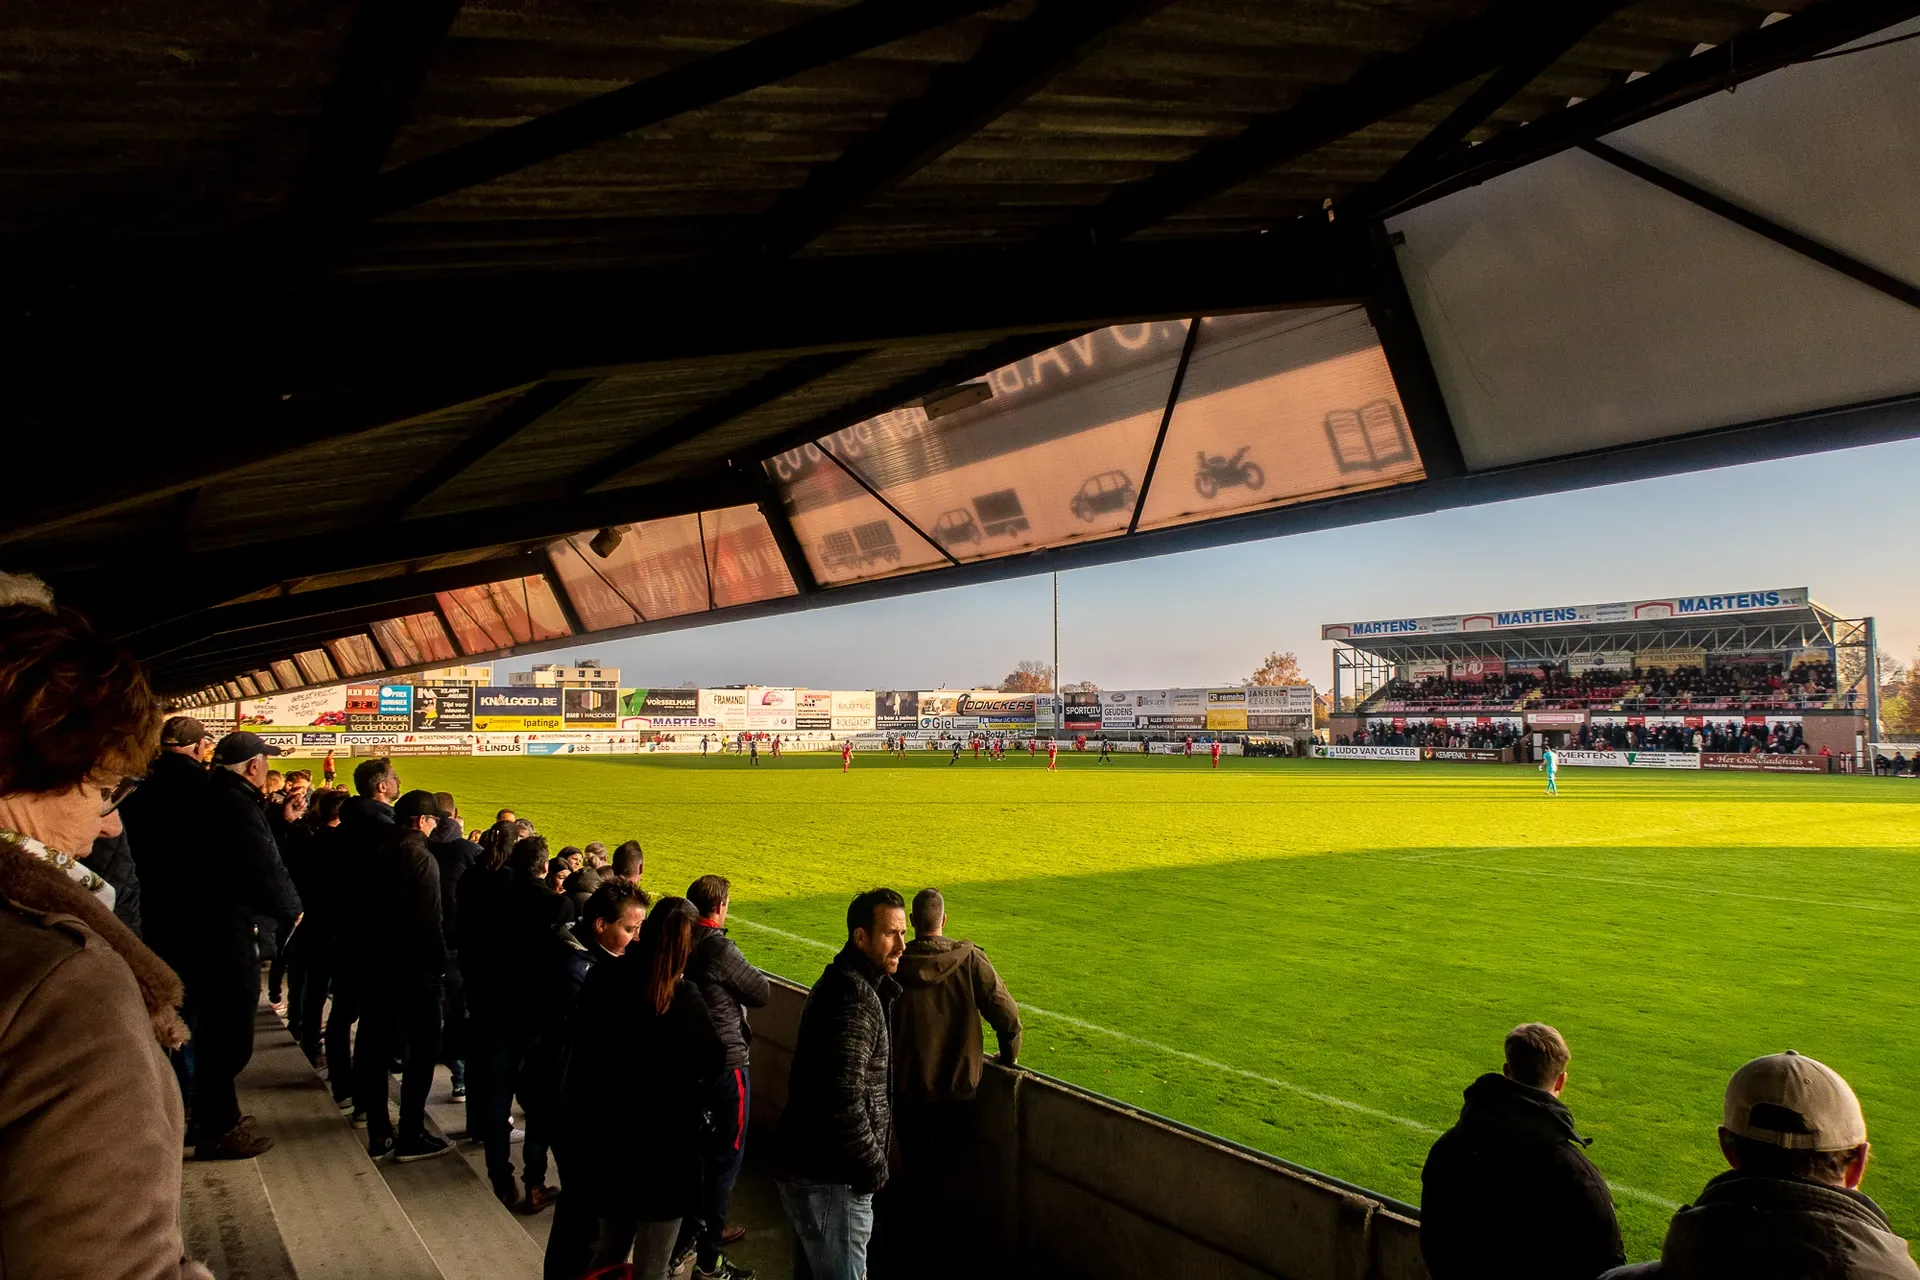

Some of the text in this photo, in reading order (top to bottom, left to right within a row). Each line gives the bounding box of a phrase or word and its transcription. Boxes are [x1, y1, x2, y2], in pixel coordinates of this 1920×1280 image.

[1679, 591, 1779, 612] MARTENS
[1498, 608, 1576, 625] MARTENS
[1353, 620, 1418, 634] MARTENS
[964, 700, 1034, 710] DONCKERS
[351, 722, 408, 732] vandenbosch
[523, 719, 559, 728] Ipatinga
[653, 718, 716, 726] MARTENS
[932, 718, 956, 728] Giel
[1716, 755, 1734, 764] Het
